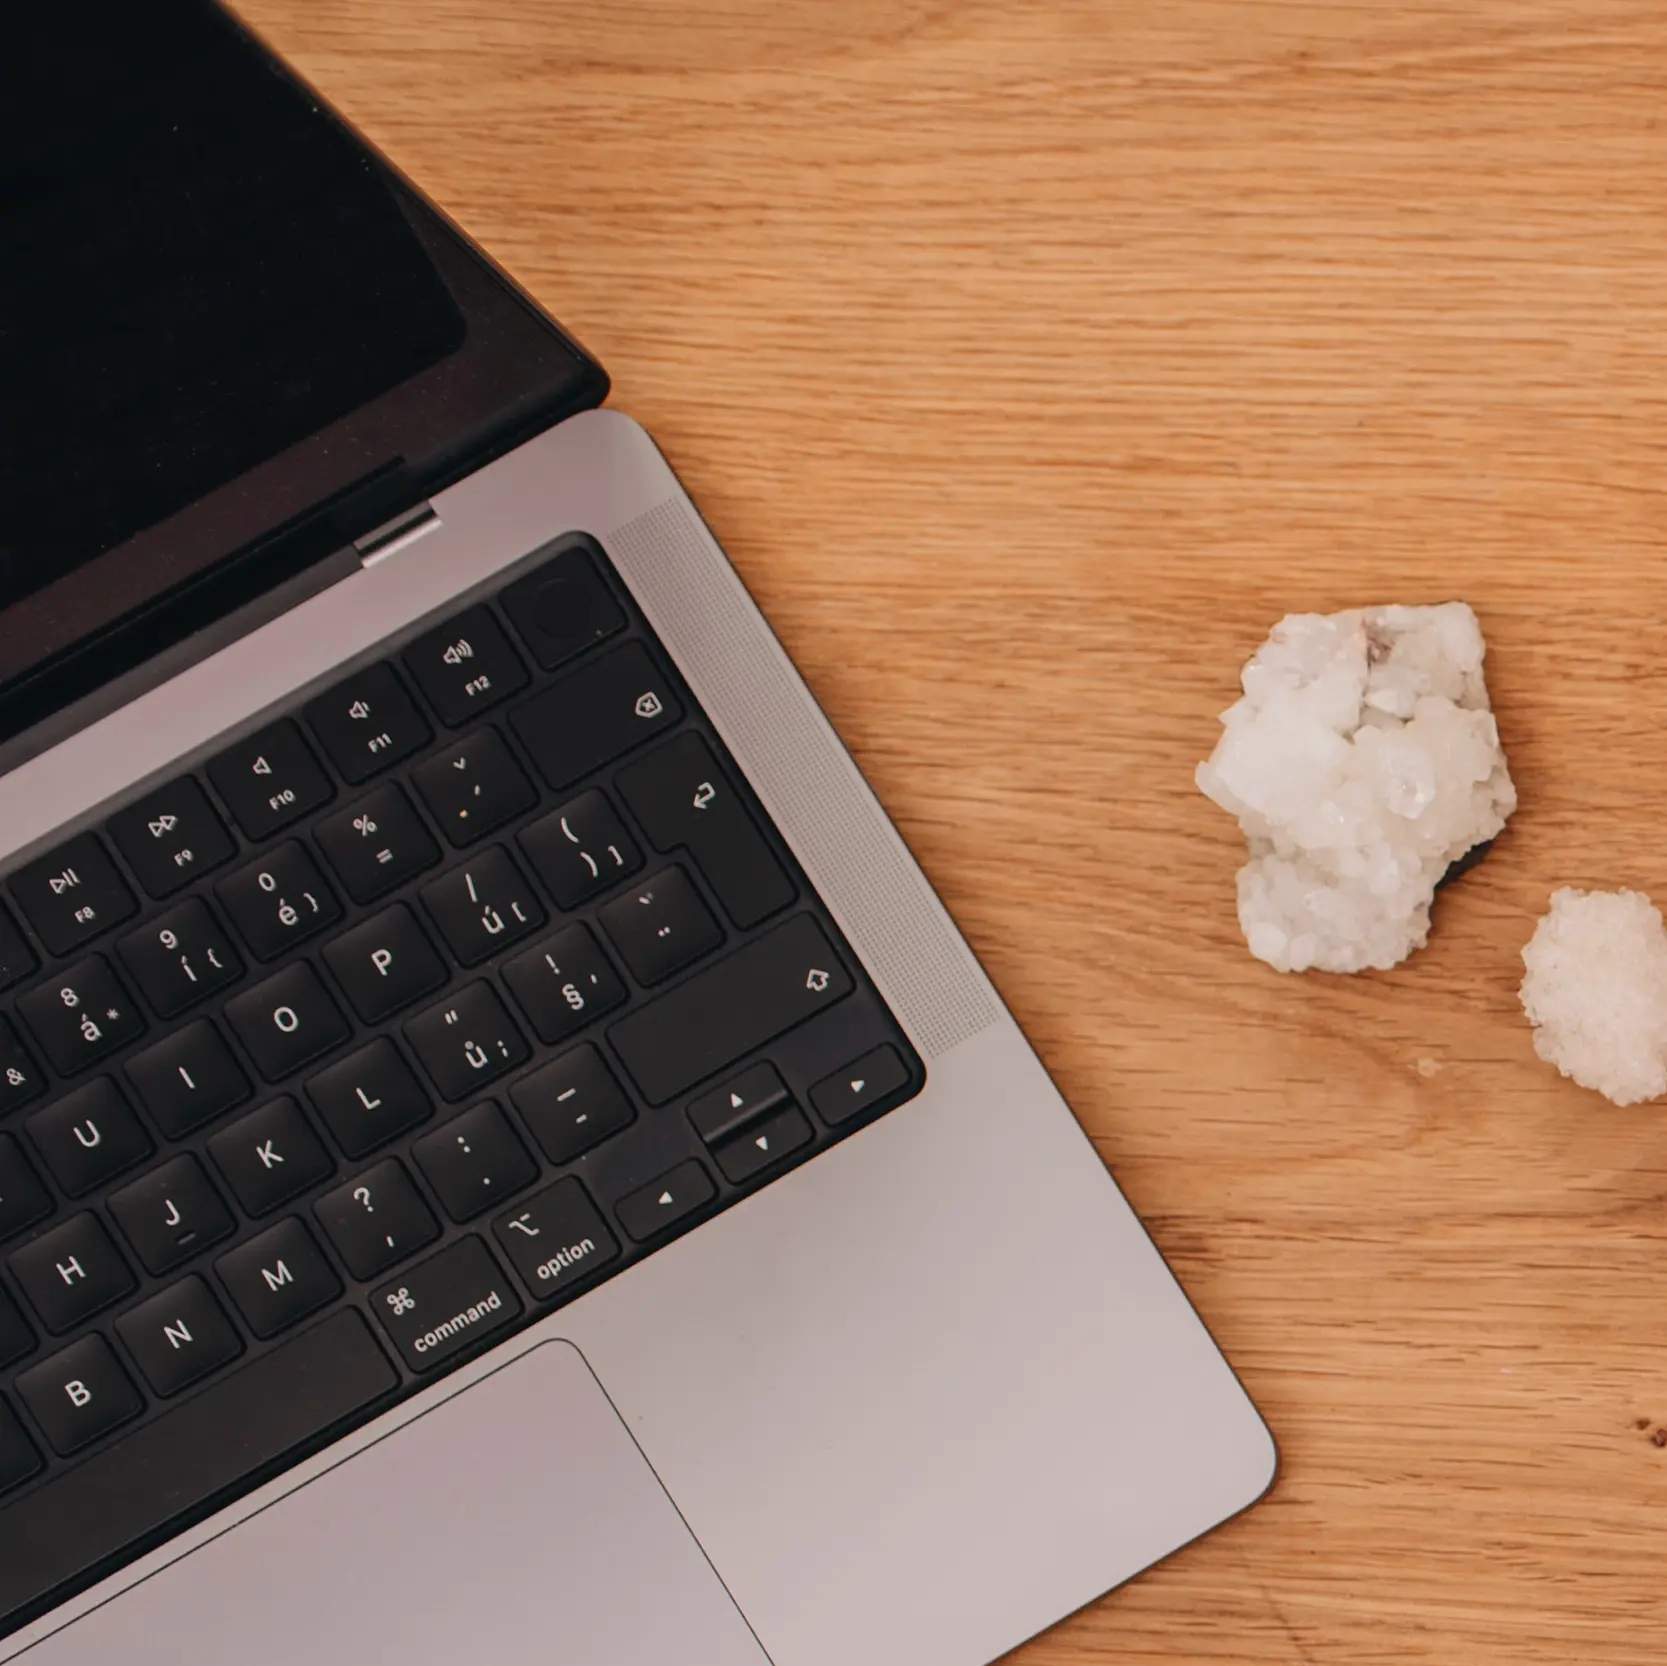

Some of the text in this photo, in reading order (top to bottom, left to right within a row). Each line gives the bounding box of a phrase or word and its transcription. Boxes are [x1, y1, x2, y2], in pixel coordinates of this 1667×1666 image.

[465, 674, 490, 696] F12
[367, 732, 392, 754] F11
[269, 789, 295, 811] F10
[352, 814, 378, 837] %
[560, 816, 579, 844] (
[174, 848, 194, 868] F9
[376, 848, 393, 864] =
[580, 851, 598, 878] )
[74, 905, 95, 924] F8
[278, 896, 298, 926] é
[481, 905, 505, 934] ú
[159, 929, 178, 950] 9
[181, 954, 197, 982] í
[371, 948, 392, 976] P
[544, 953, 561, 975] !
[60, 987, 79, 1007] 8
[561, 983, 585, 1011] §
[80, 1012, 102, 1042] á
[273, 1006, 299, 1033] O
[464, 1040, 489, 1069] ů
[6, 1067, 26, 1086] &
[178, 1066, 195, 1089] I
[355, 1087, 381, 1110] L
[73, 1119, 101, 1148] U
[255, 1139, 284, 1169] K
[165, 1199, 181, 1226] J
[353, 1186, 374, 1213] ?
[55, 1255, 86, 1285] H
[536, 1235, 596, 1282] option
[261, 1259, 294, 1292] M
[163, 1319, 193, 1349] N
[413, 1290, 503, 1354] command
[64, 1380, 92, 1407] B
